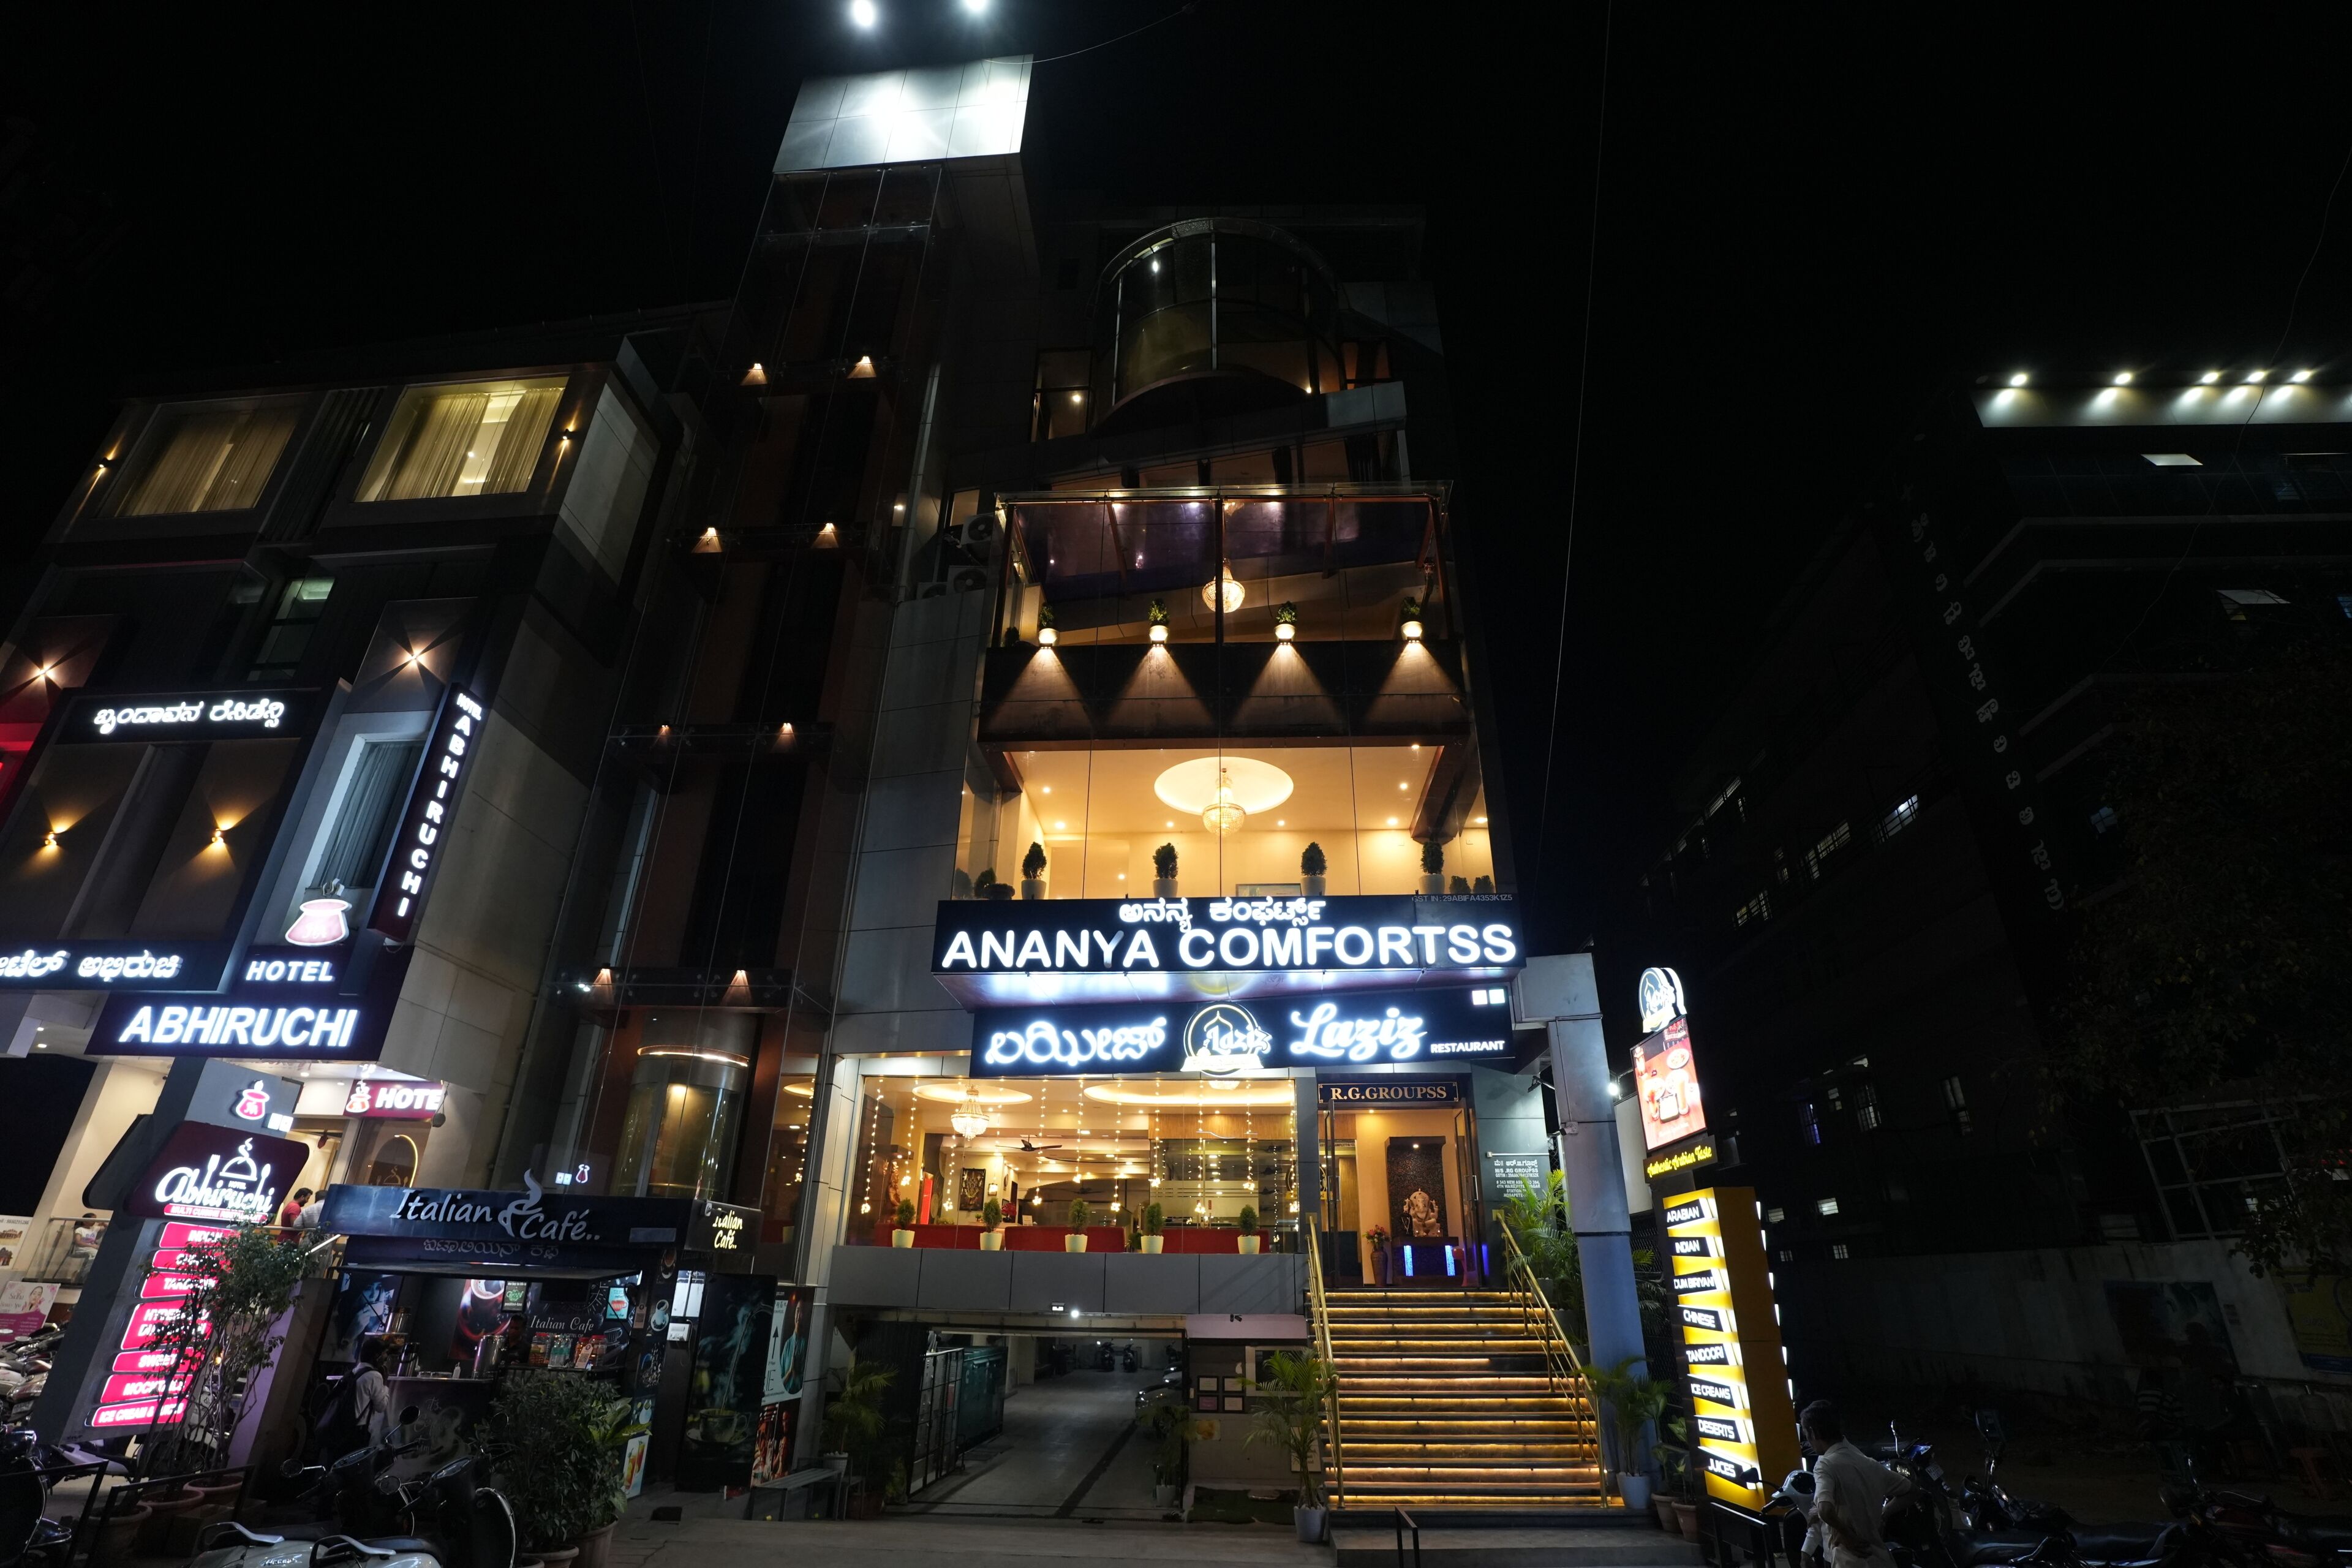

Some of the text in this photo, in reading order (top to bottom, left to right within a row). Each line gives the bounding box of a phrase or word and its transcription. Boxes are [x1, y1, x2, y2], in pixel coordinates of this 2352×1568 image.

[398, 693, 482, 917] HOTEL ABHIRUCHI
[941, 924, 1517, 968] ANANYA COMFORTSS
[246, 960, 334, 981] HOTEL
[118, 1006, 358, 1047] ABHIRUCHI
[1289, 1003, 1505, 1061] Laziz RESTAURANT
[1330, 1086, 1447, 1100] R.G.GROUPSS
[1672, 1152, 1695, 1170] Arabian
[1695, 1145, 1712, 1161] Taste
[228, 1180, 247, 1189] HOTEL
[171, 1205, 193, 1215] MULTI
[388, 1189, 493, 1223] Italian
[1667, 1205, 1700, 1223] ARABIAN
[1675, 1239, 1700, 1254] INDIAN
[1673, 1278, 1688, 1289] DUM
[530, 1315, 594, 1333] Italian Cafe
[1683, 1309, 1716, 1328] CHINESE
[1686, 1346, 1725, 1362] TANDOORI
[1691, 1383, 1731, 1400] ICE CREAMS
[98, 1410, 116, 1423] ICE
[115, 1407, 148, 1421] CREAM
[1698, 1419, 1735, 1439] DESERTS
[1708, 1458, 1736, 1478] JUICES
